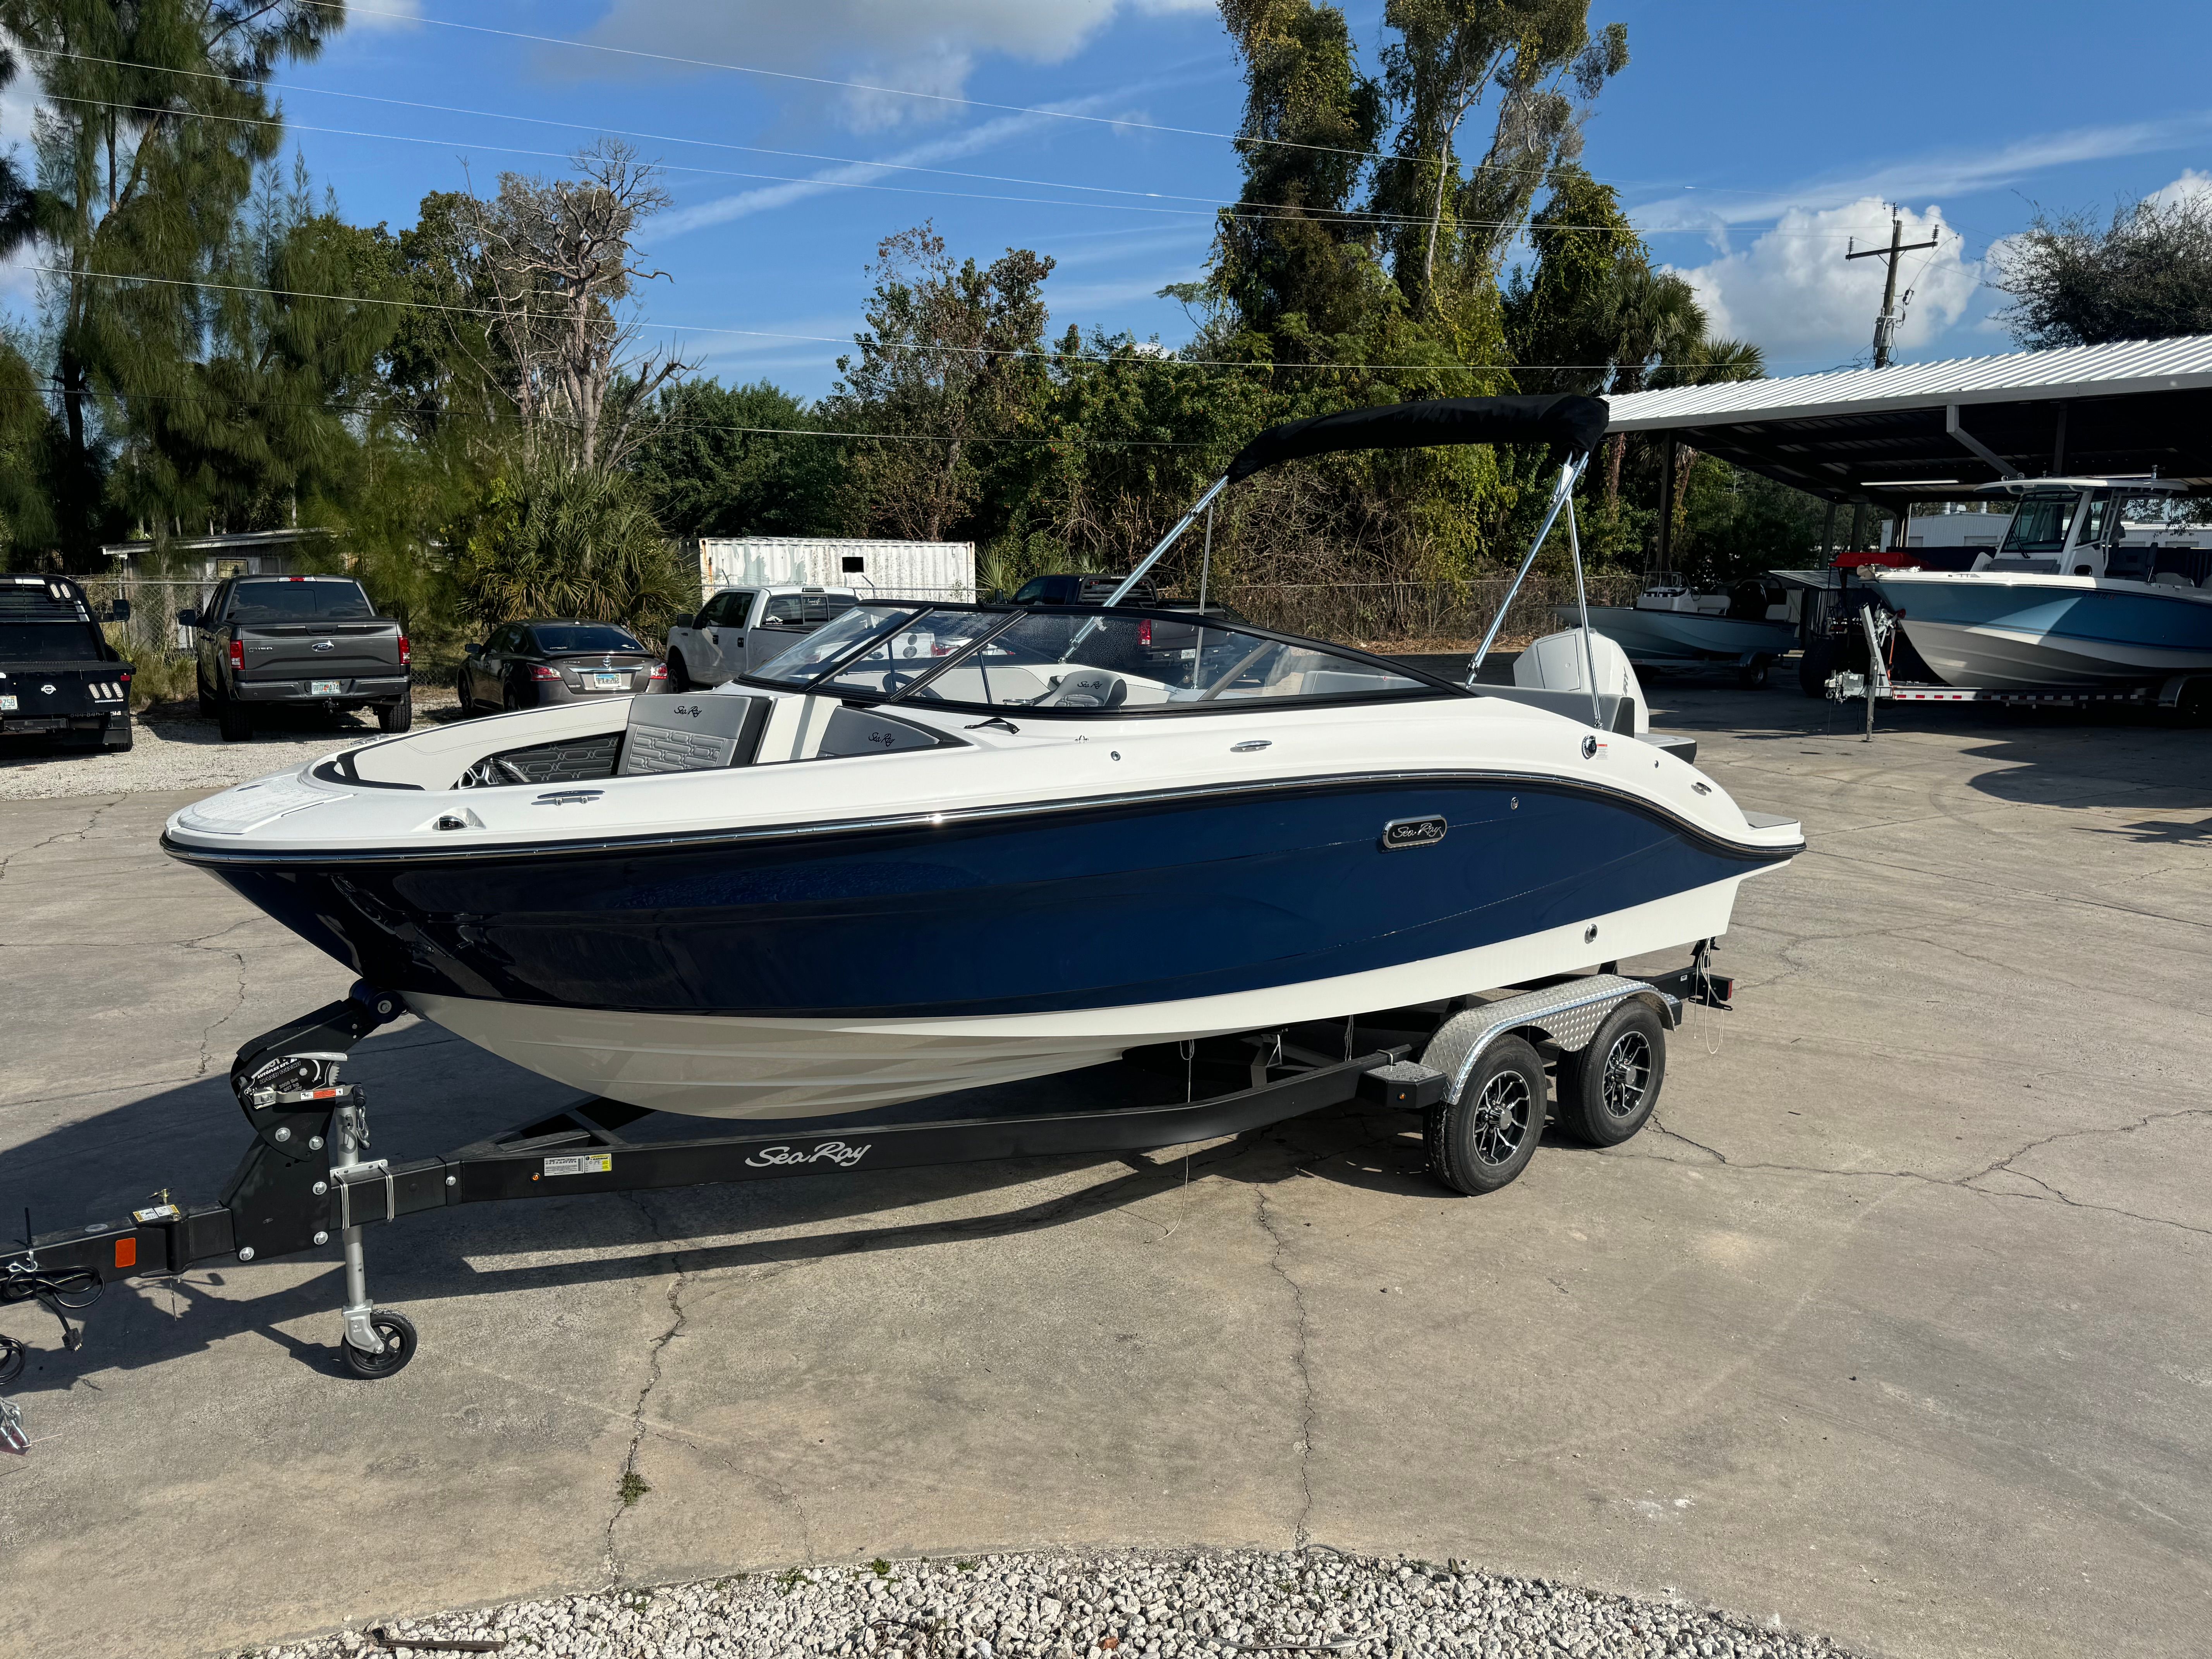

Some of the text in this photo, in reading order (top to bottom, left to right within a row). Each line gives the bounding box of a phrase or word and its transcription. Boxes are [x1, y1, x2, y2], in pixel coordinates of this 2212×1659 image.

[1090, 681, 1103, 689] Ray
[674, 706, 702, 717] Sea Ray
[868, 732, 895, 747] Sea Ray
[1392, 823, 1441, 838] Sea Ray
[745, 1142, 872, 1167] Sea Ray
